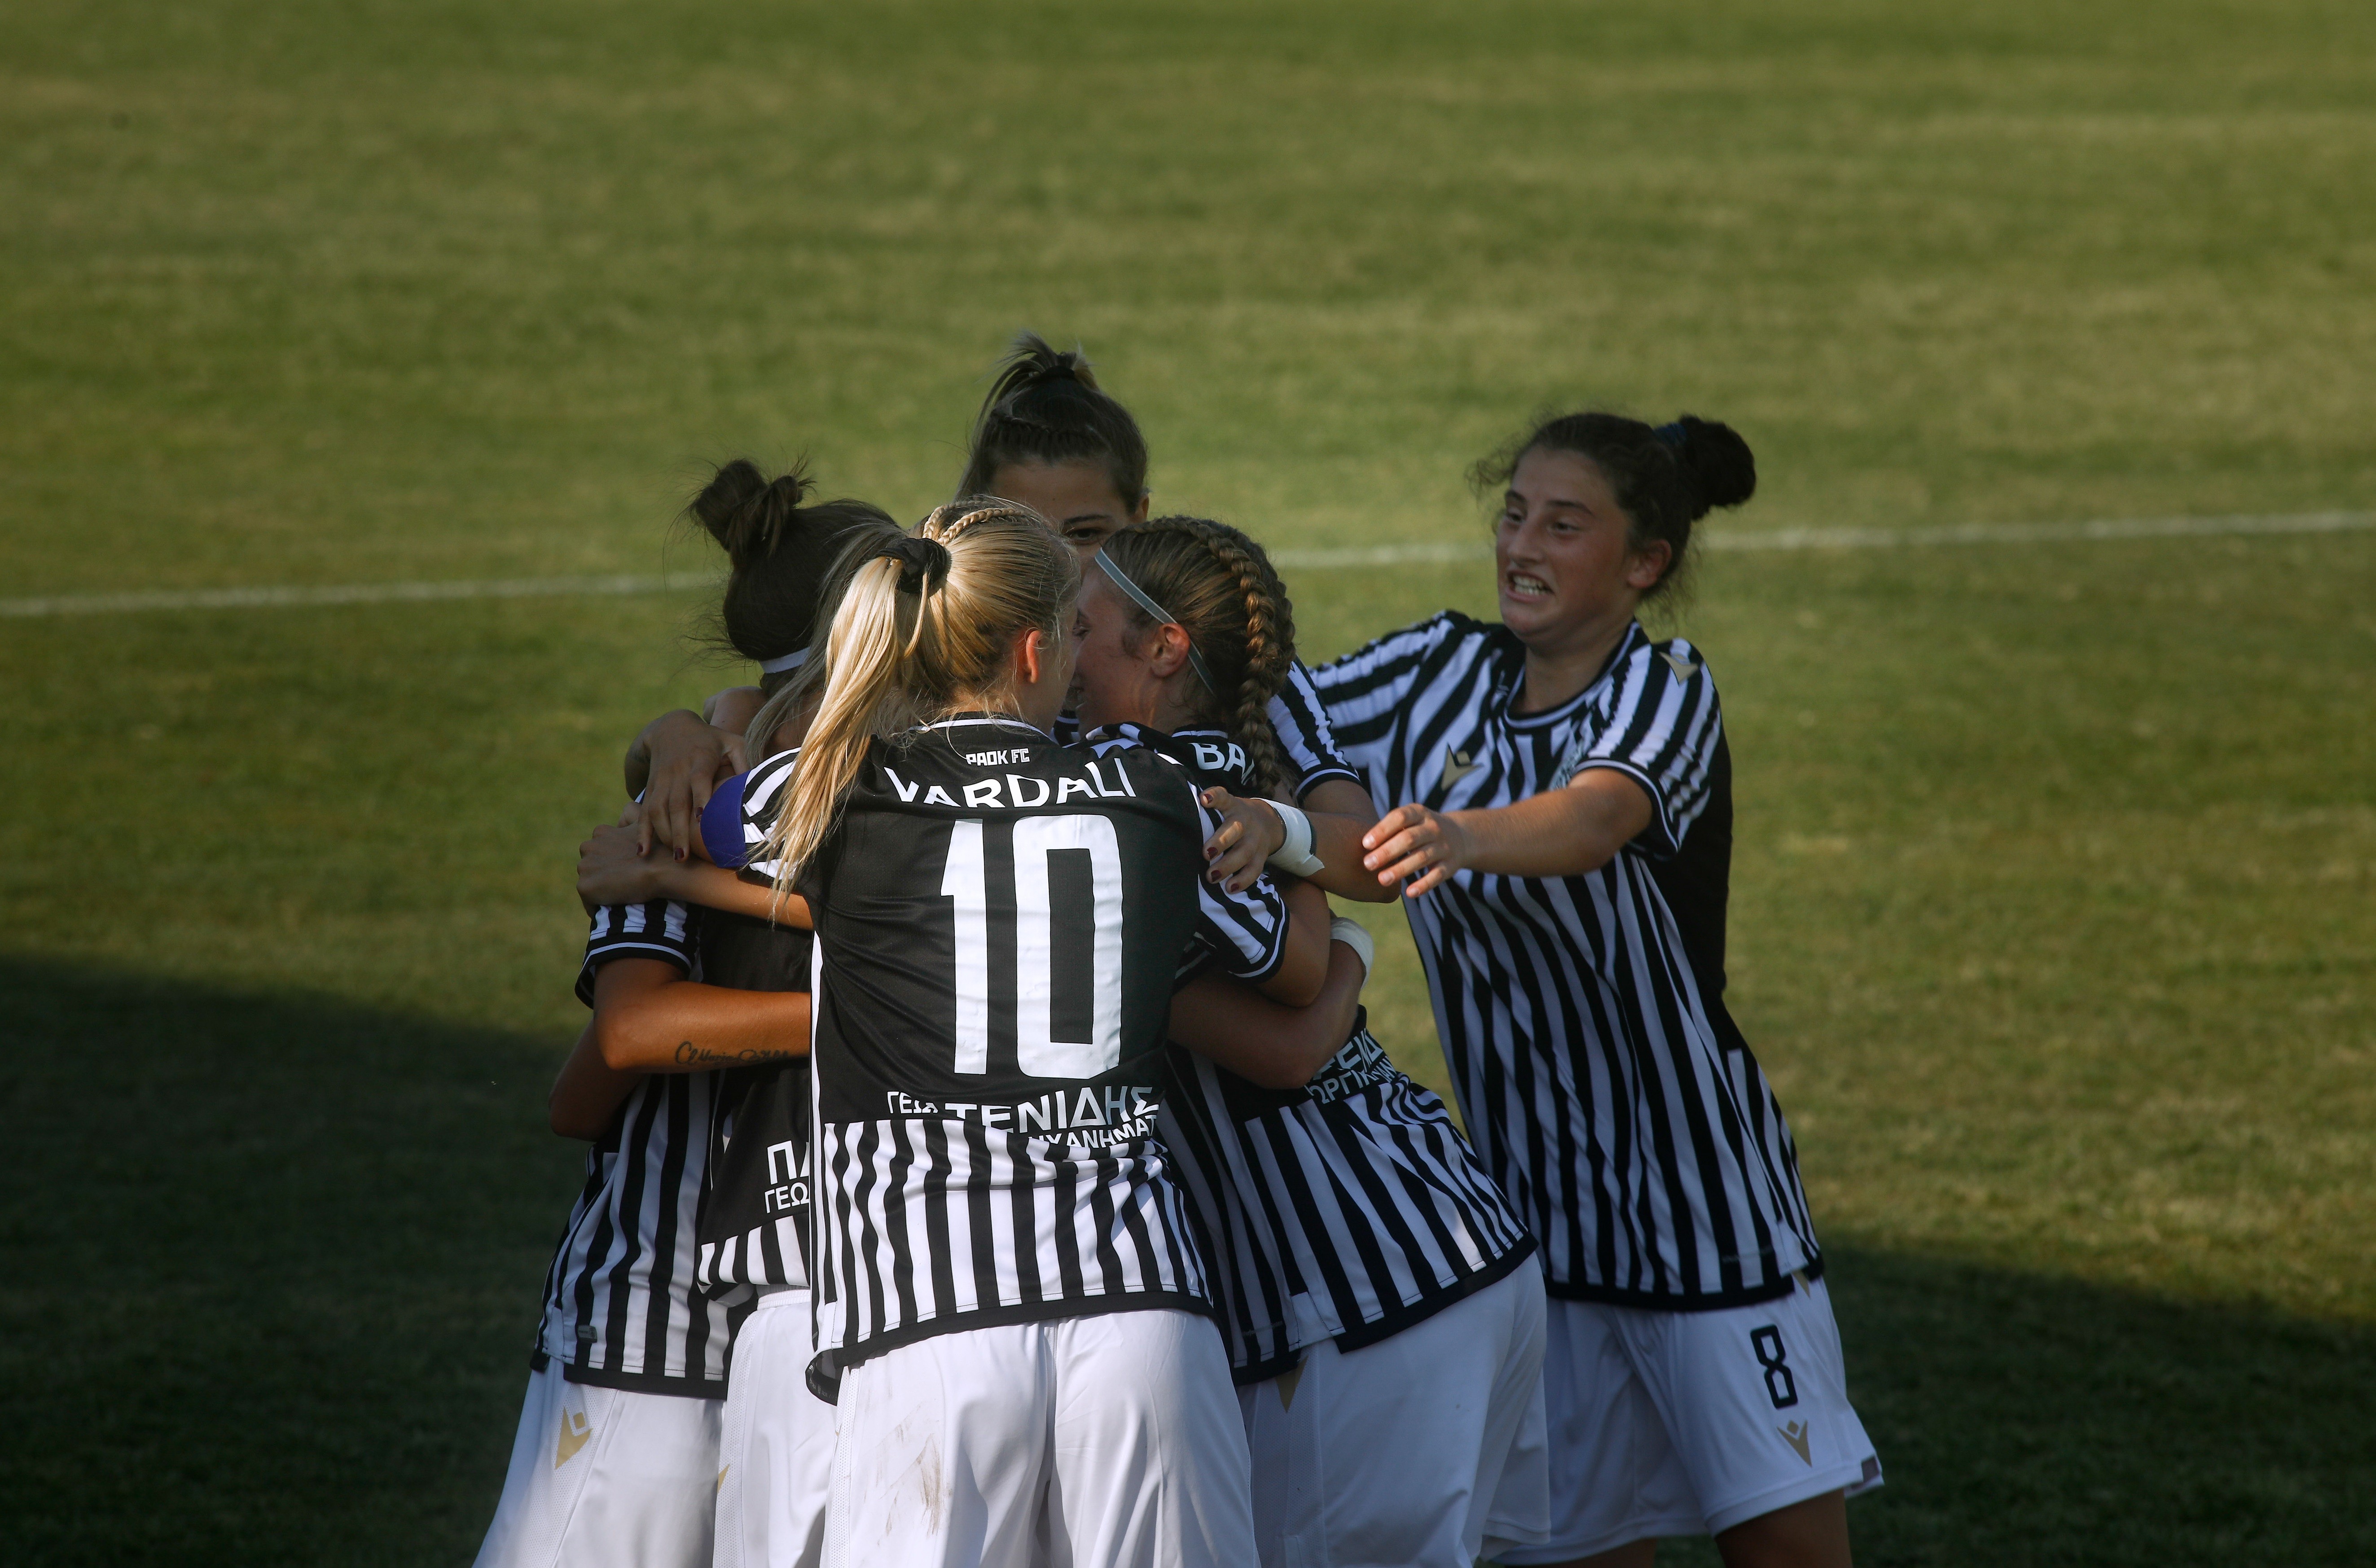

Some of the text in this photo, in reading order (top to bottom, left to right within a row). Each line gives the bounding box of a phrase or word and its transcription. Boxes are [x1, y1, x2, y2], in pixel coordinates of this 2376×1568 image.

[884, 757, 1137, 808] VARDALI
[966, 748, 1030, 766] PAOK FC
[941, 814, 1123, 1079] 10
[1750, 1324, 1798, 1410] 8
